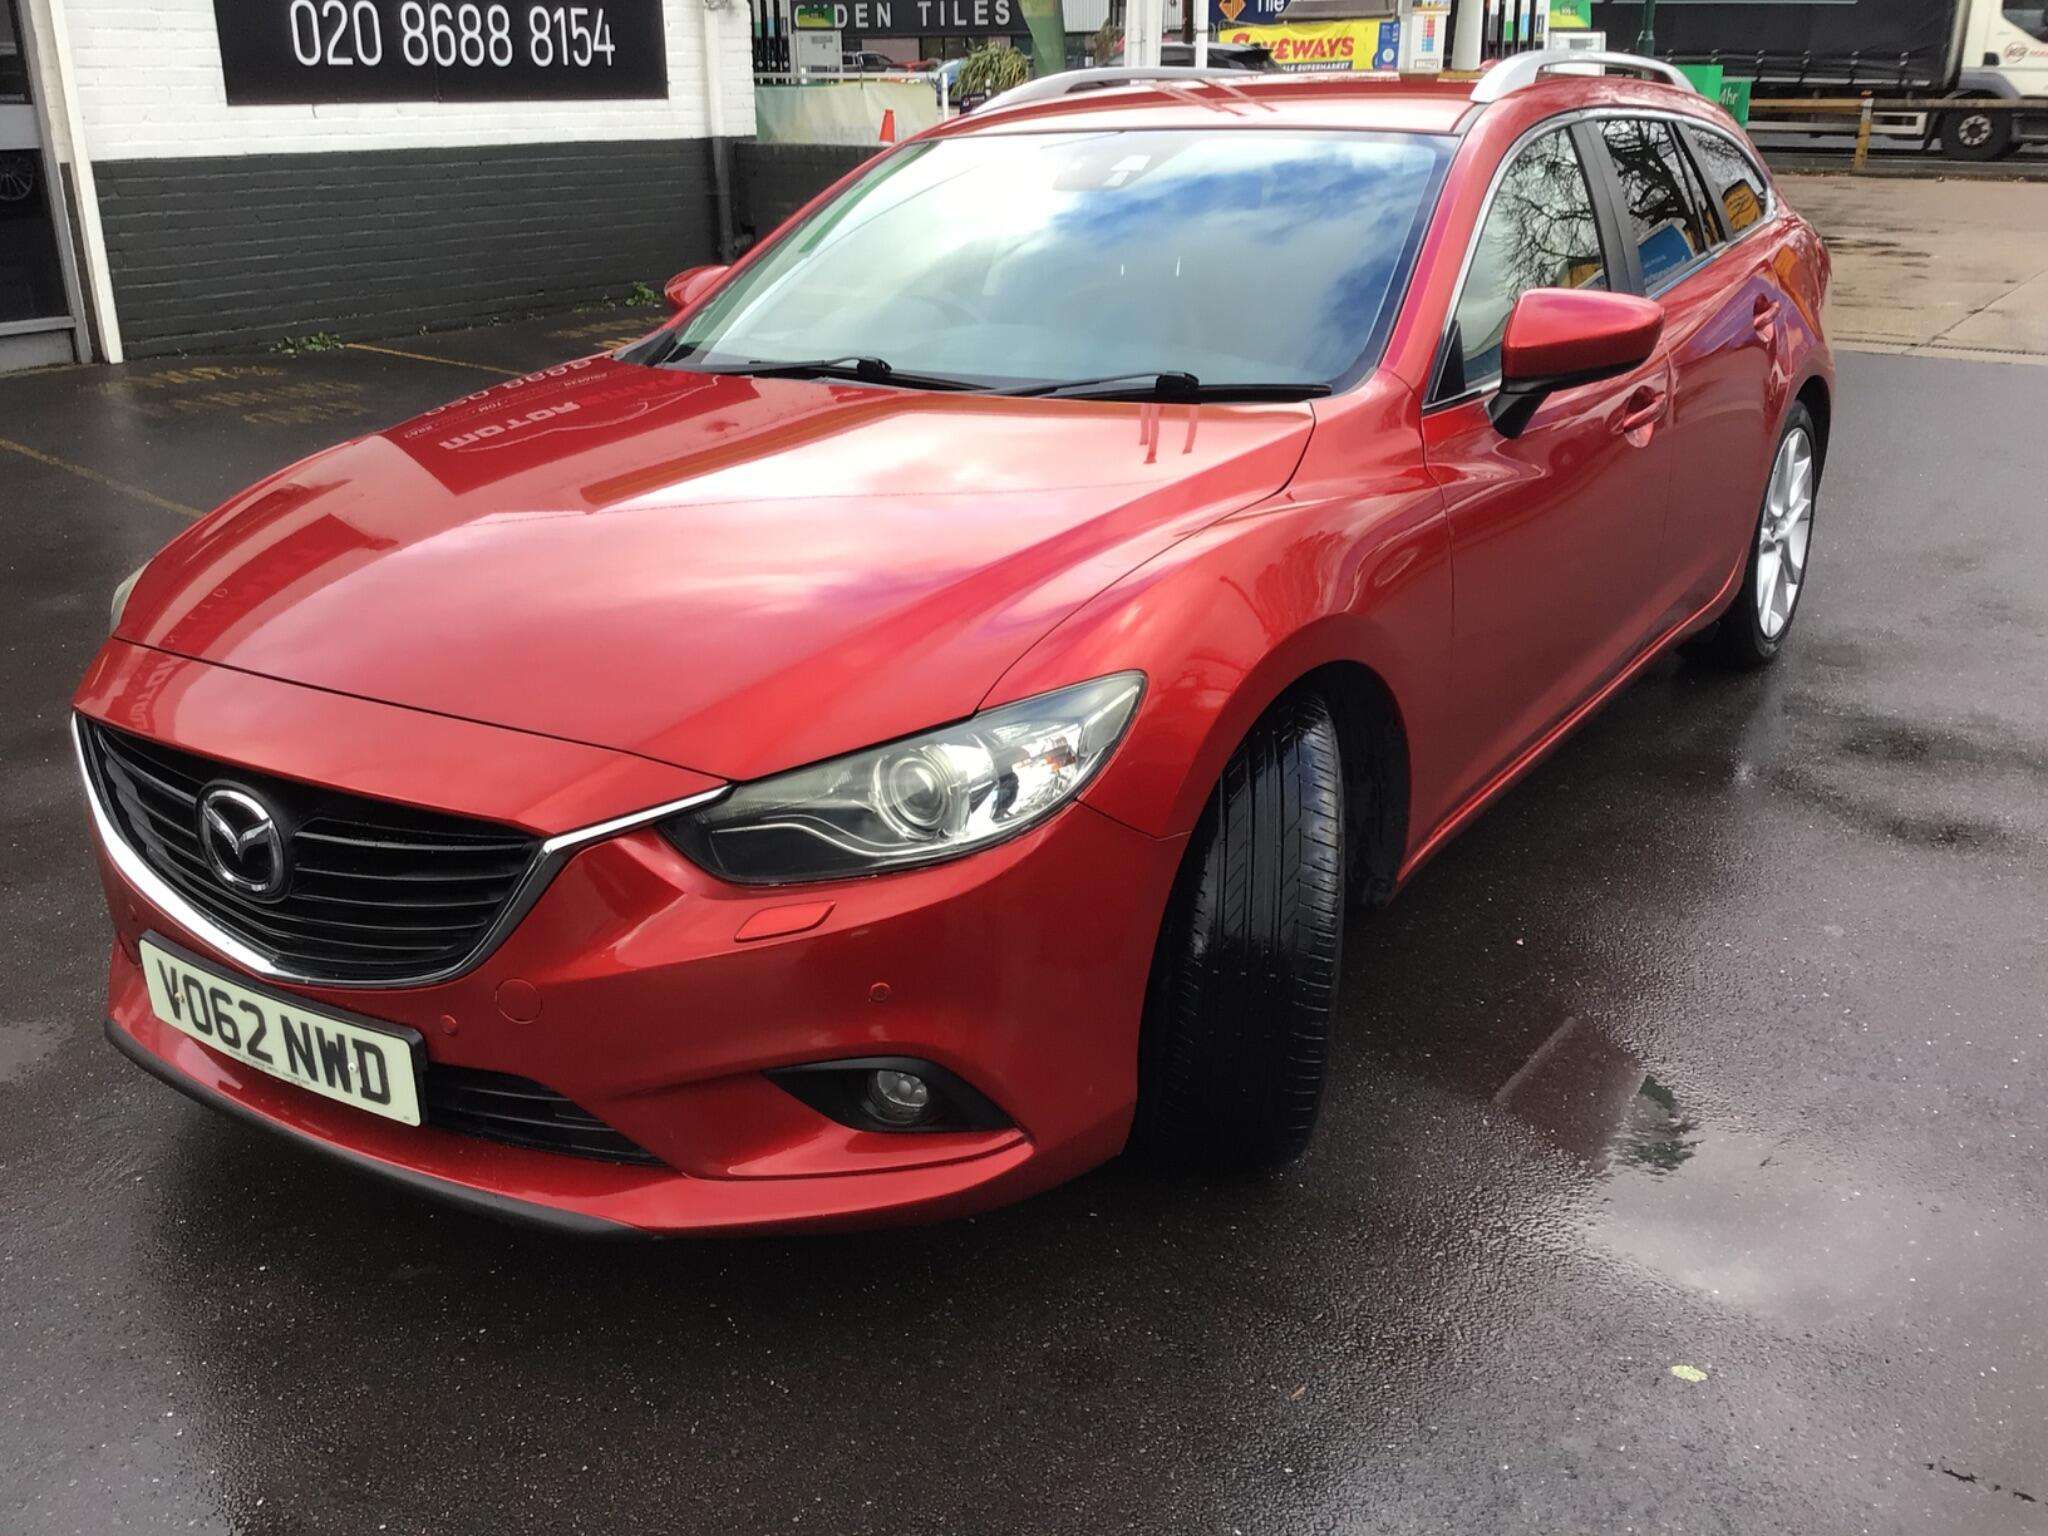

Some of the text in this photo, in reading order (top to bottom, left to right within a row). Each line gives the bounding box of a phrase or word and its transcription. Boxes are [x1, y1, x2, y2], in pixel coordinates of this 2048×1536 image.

[290, 0, 616, 67] 020 8688 8154
[917, 0, 1011, 26] TILES
[157, 959, 274, 1065] VO62
[280, 1015, 392, 1106] NWD
